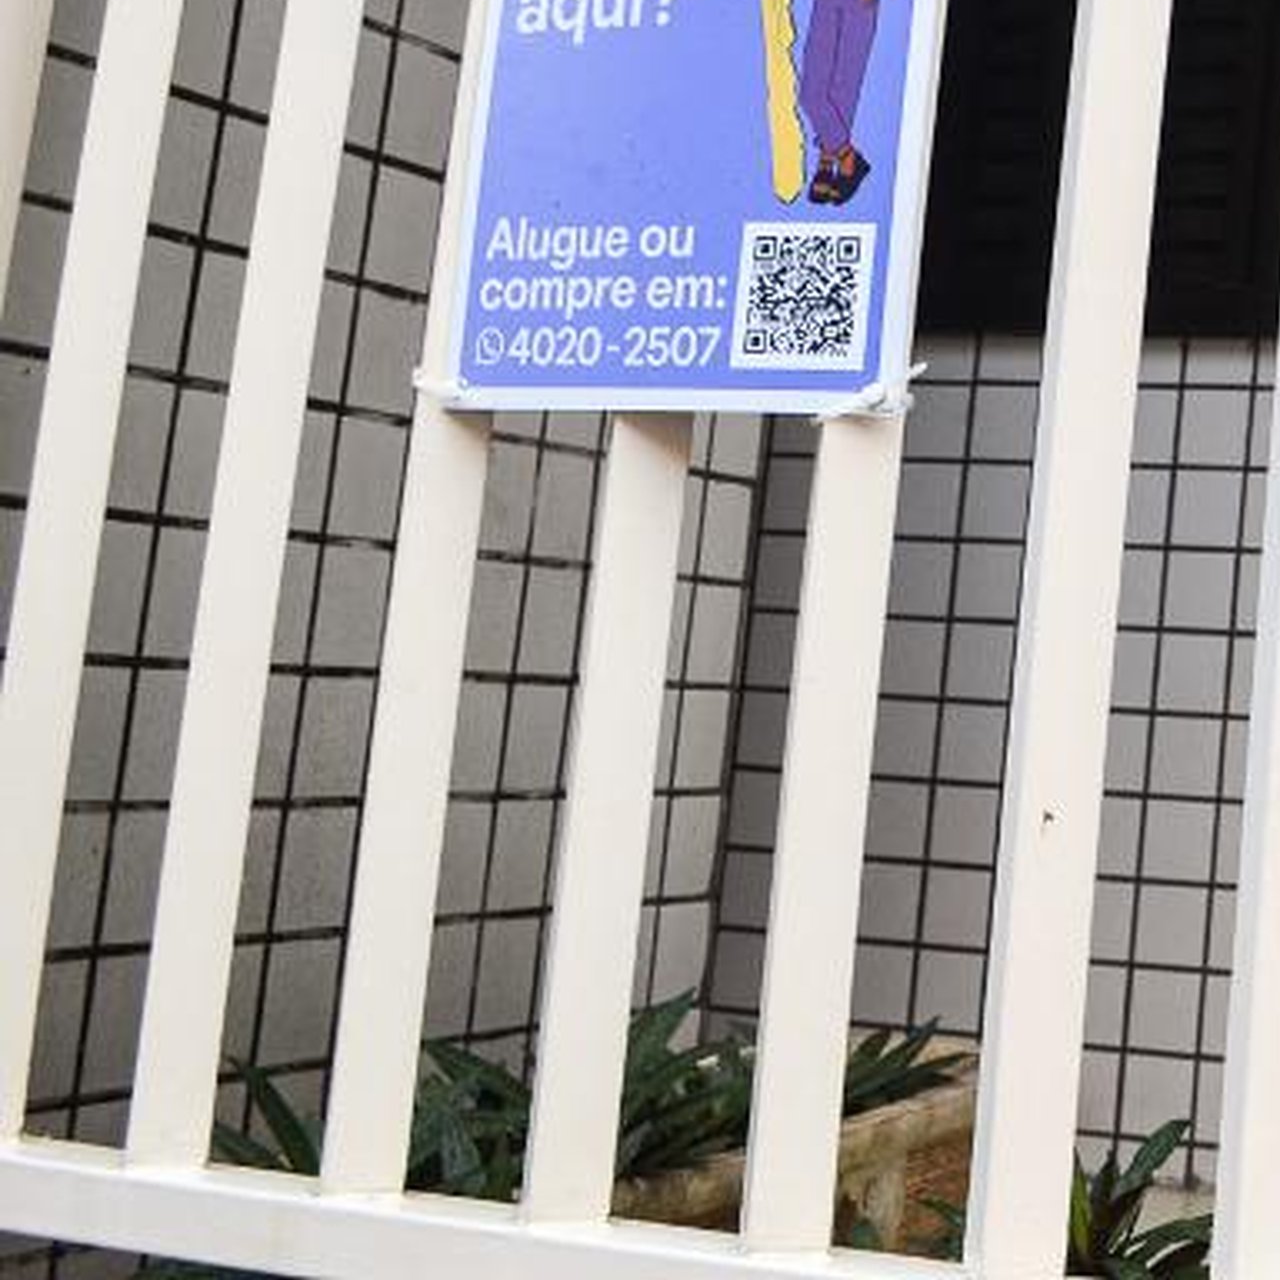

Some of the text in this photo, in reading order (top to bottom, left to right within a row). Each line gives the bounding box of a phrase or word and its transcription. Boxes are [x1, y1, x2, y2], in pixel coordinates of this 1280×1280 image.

[486, 216, 695, 270] Alugue ou
[479, 275, 728, 321] compre em:
